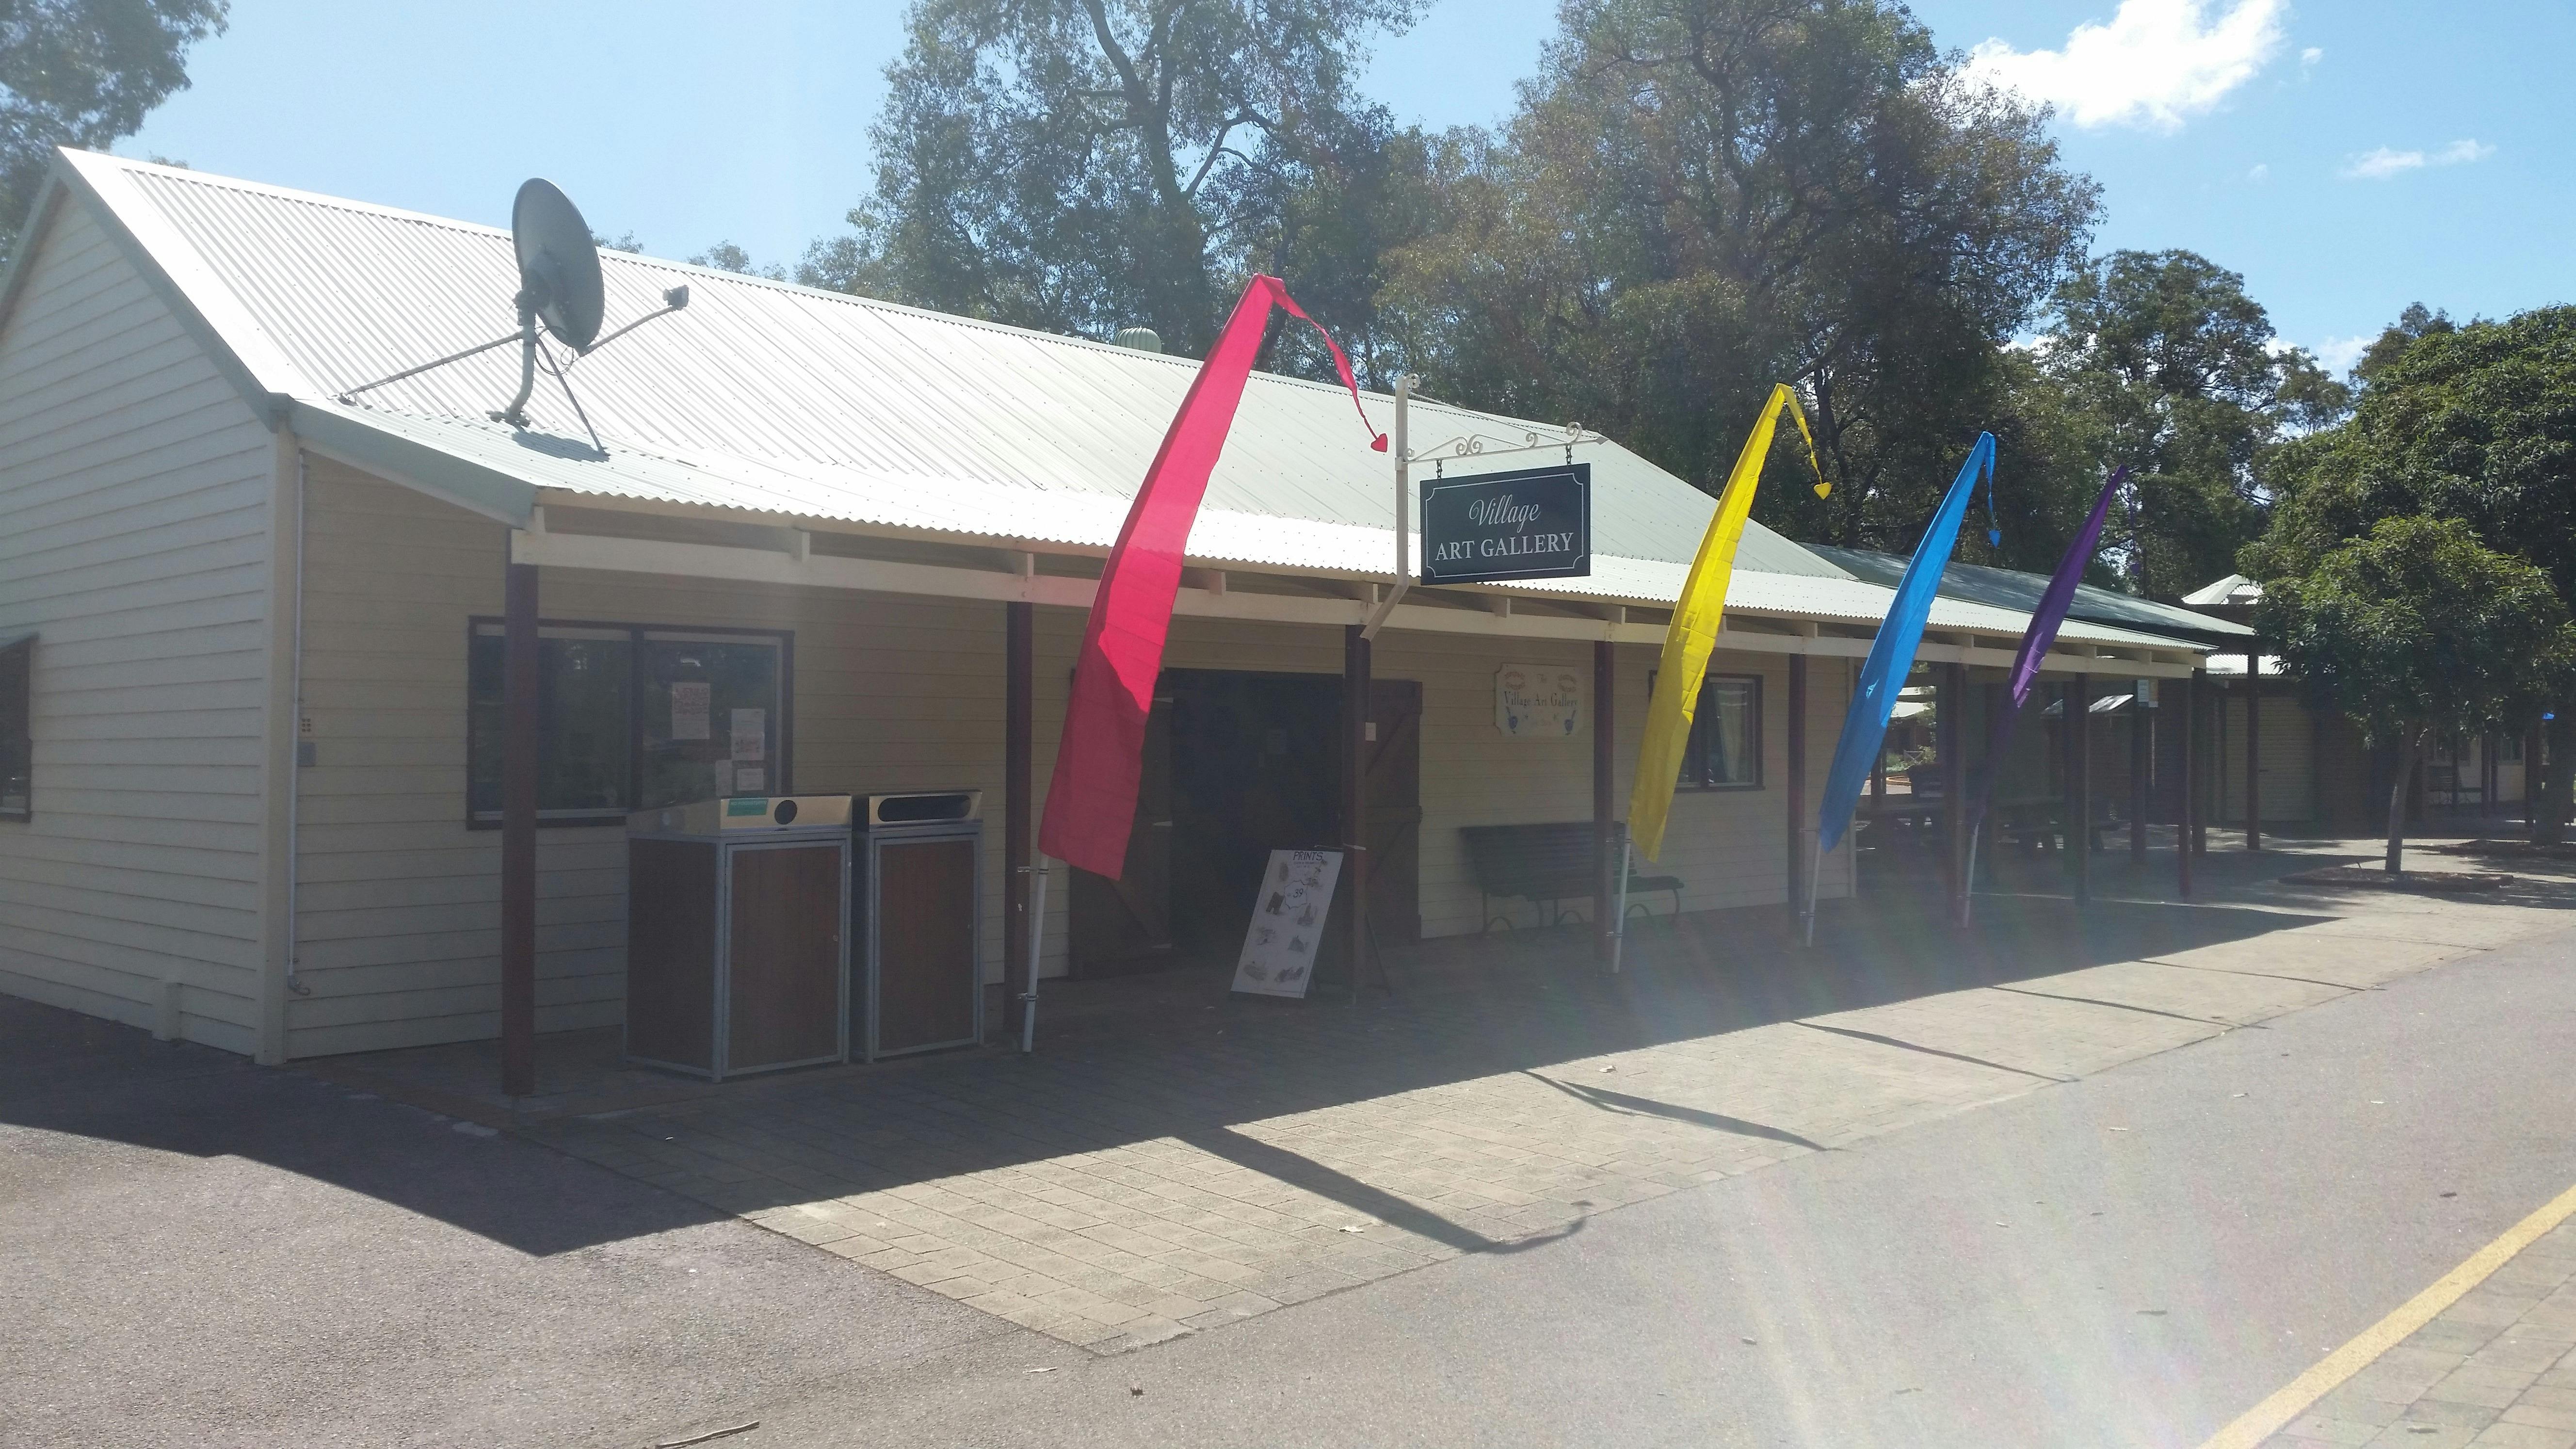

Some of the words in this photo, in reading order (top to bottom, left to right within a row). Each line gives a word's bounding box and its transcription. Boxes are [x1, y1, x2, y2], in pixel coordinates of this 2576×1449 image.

[1469, 494, 1541, 533] Village
[1435, 540, 1475, 561] ART
[1481, 532, 1574, 557] GALLERY
[1504, 691, 1531, 708] Village
[1534, 693, 1547, 706] Art
[1550, 693, 1578, 707] Gallery
[1293, 851, 1323, 861] PRINTS
